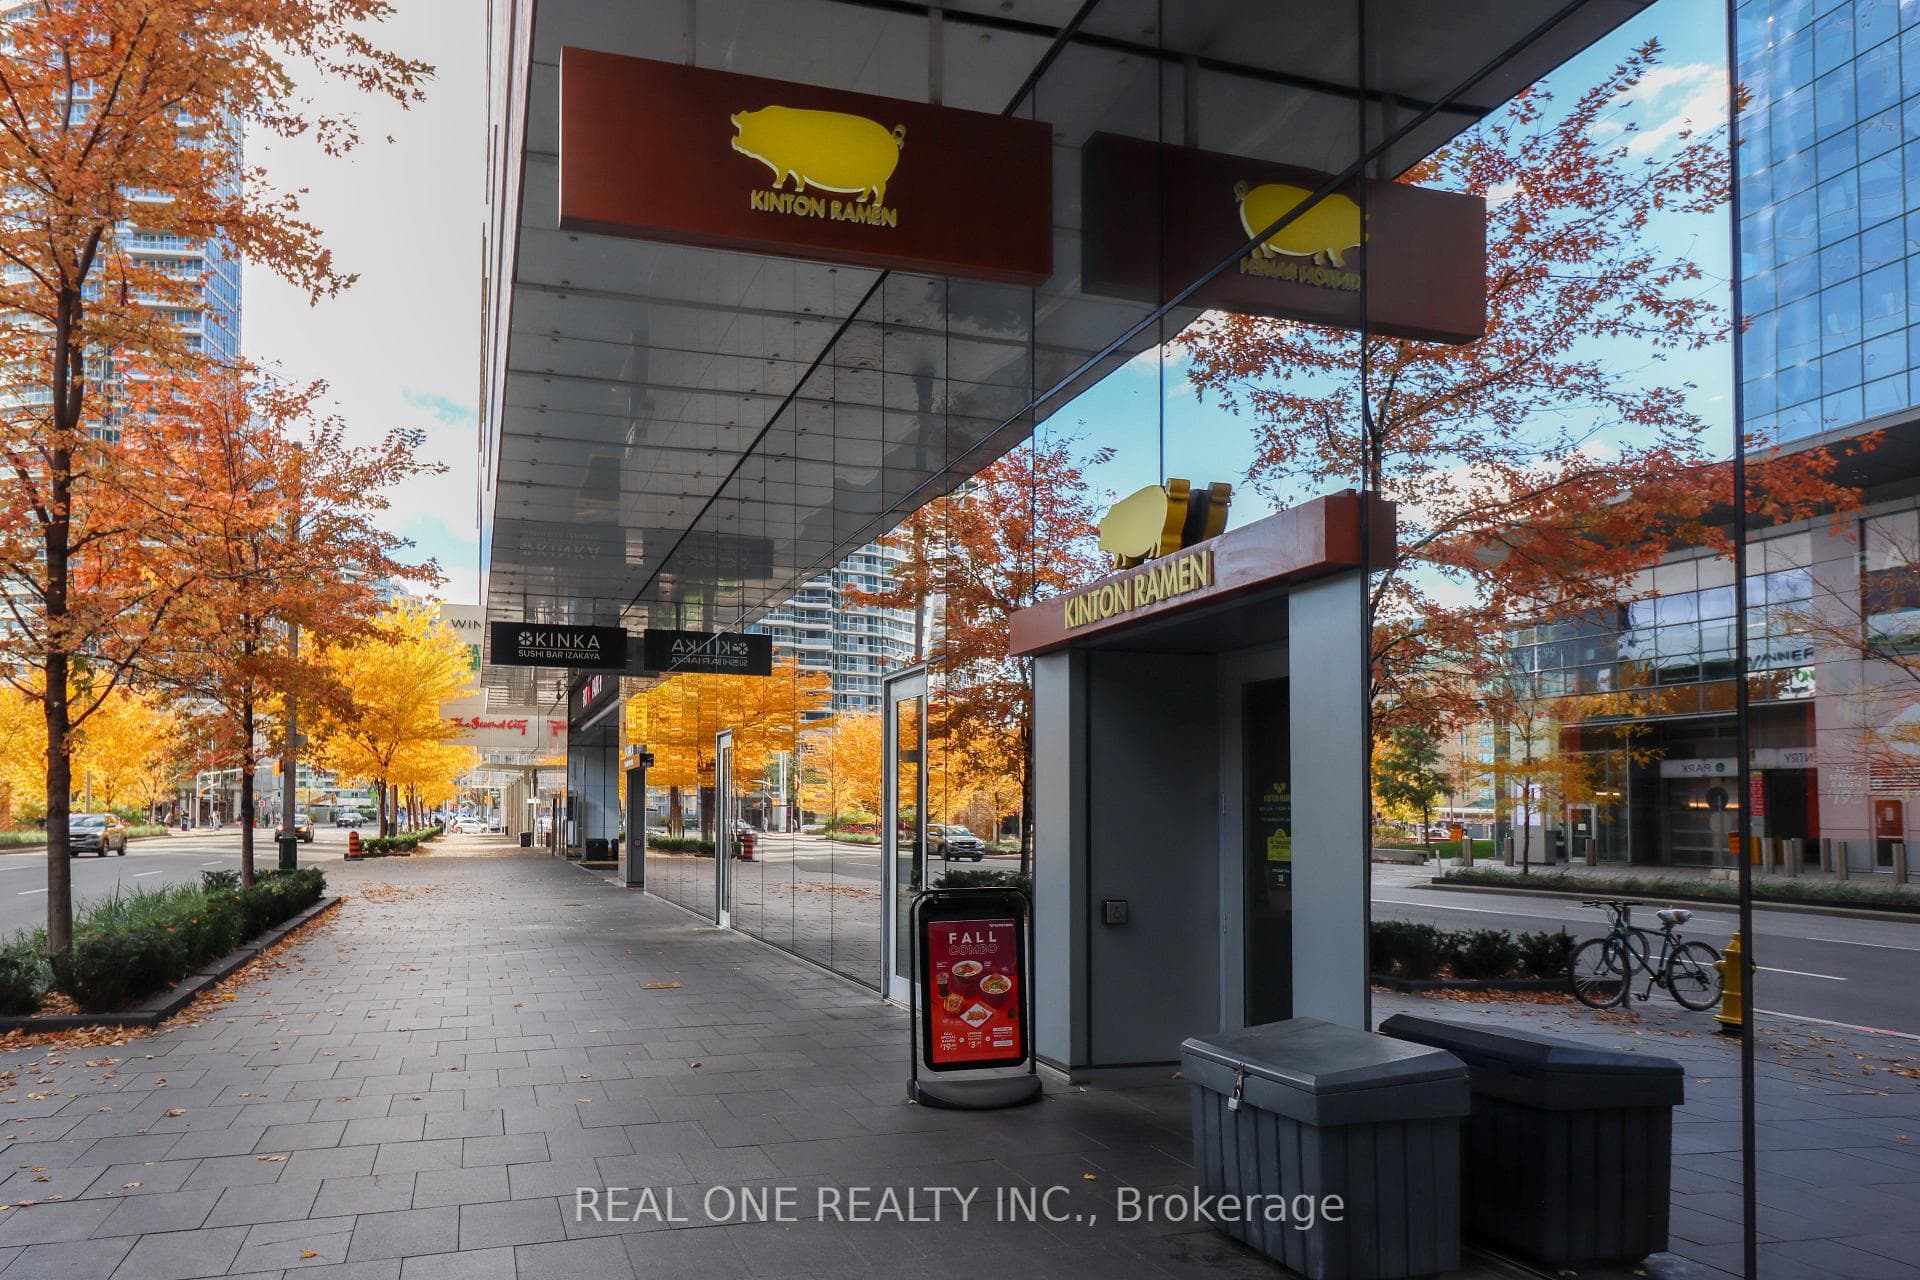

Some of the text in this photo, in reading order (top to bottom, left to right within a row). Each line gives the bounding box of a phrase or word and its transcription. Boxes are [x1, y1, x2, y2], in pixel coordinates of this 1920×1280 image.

[750, 189, 898, 229] KINTON RAMEN
[1064, 549, 1213, 630] KINTON RAMEN
[535, 631, 600, 649] KINKA
[518, 650, 600, 660] SUSHI BAR IZAKAYA
[471, 716, 506, 730] Second
[507, 719, 529, 737] City
[948, 931, 997, 944] FALL
[948, 943, 998, 956] COMBO
